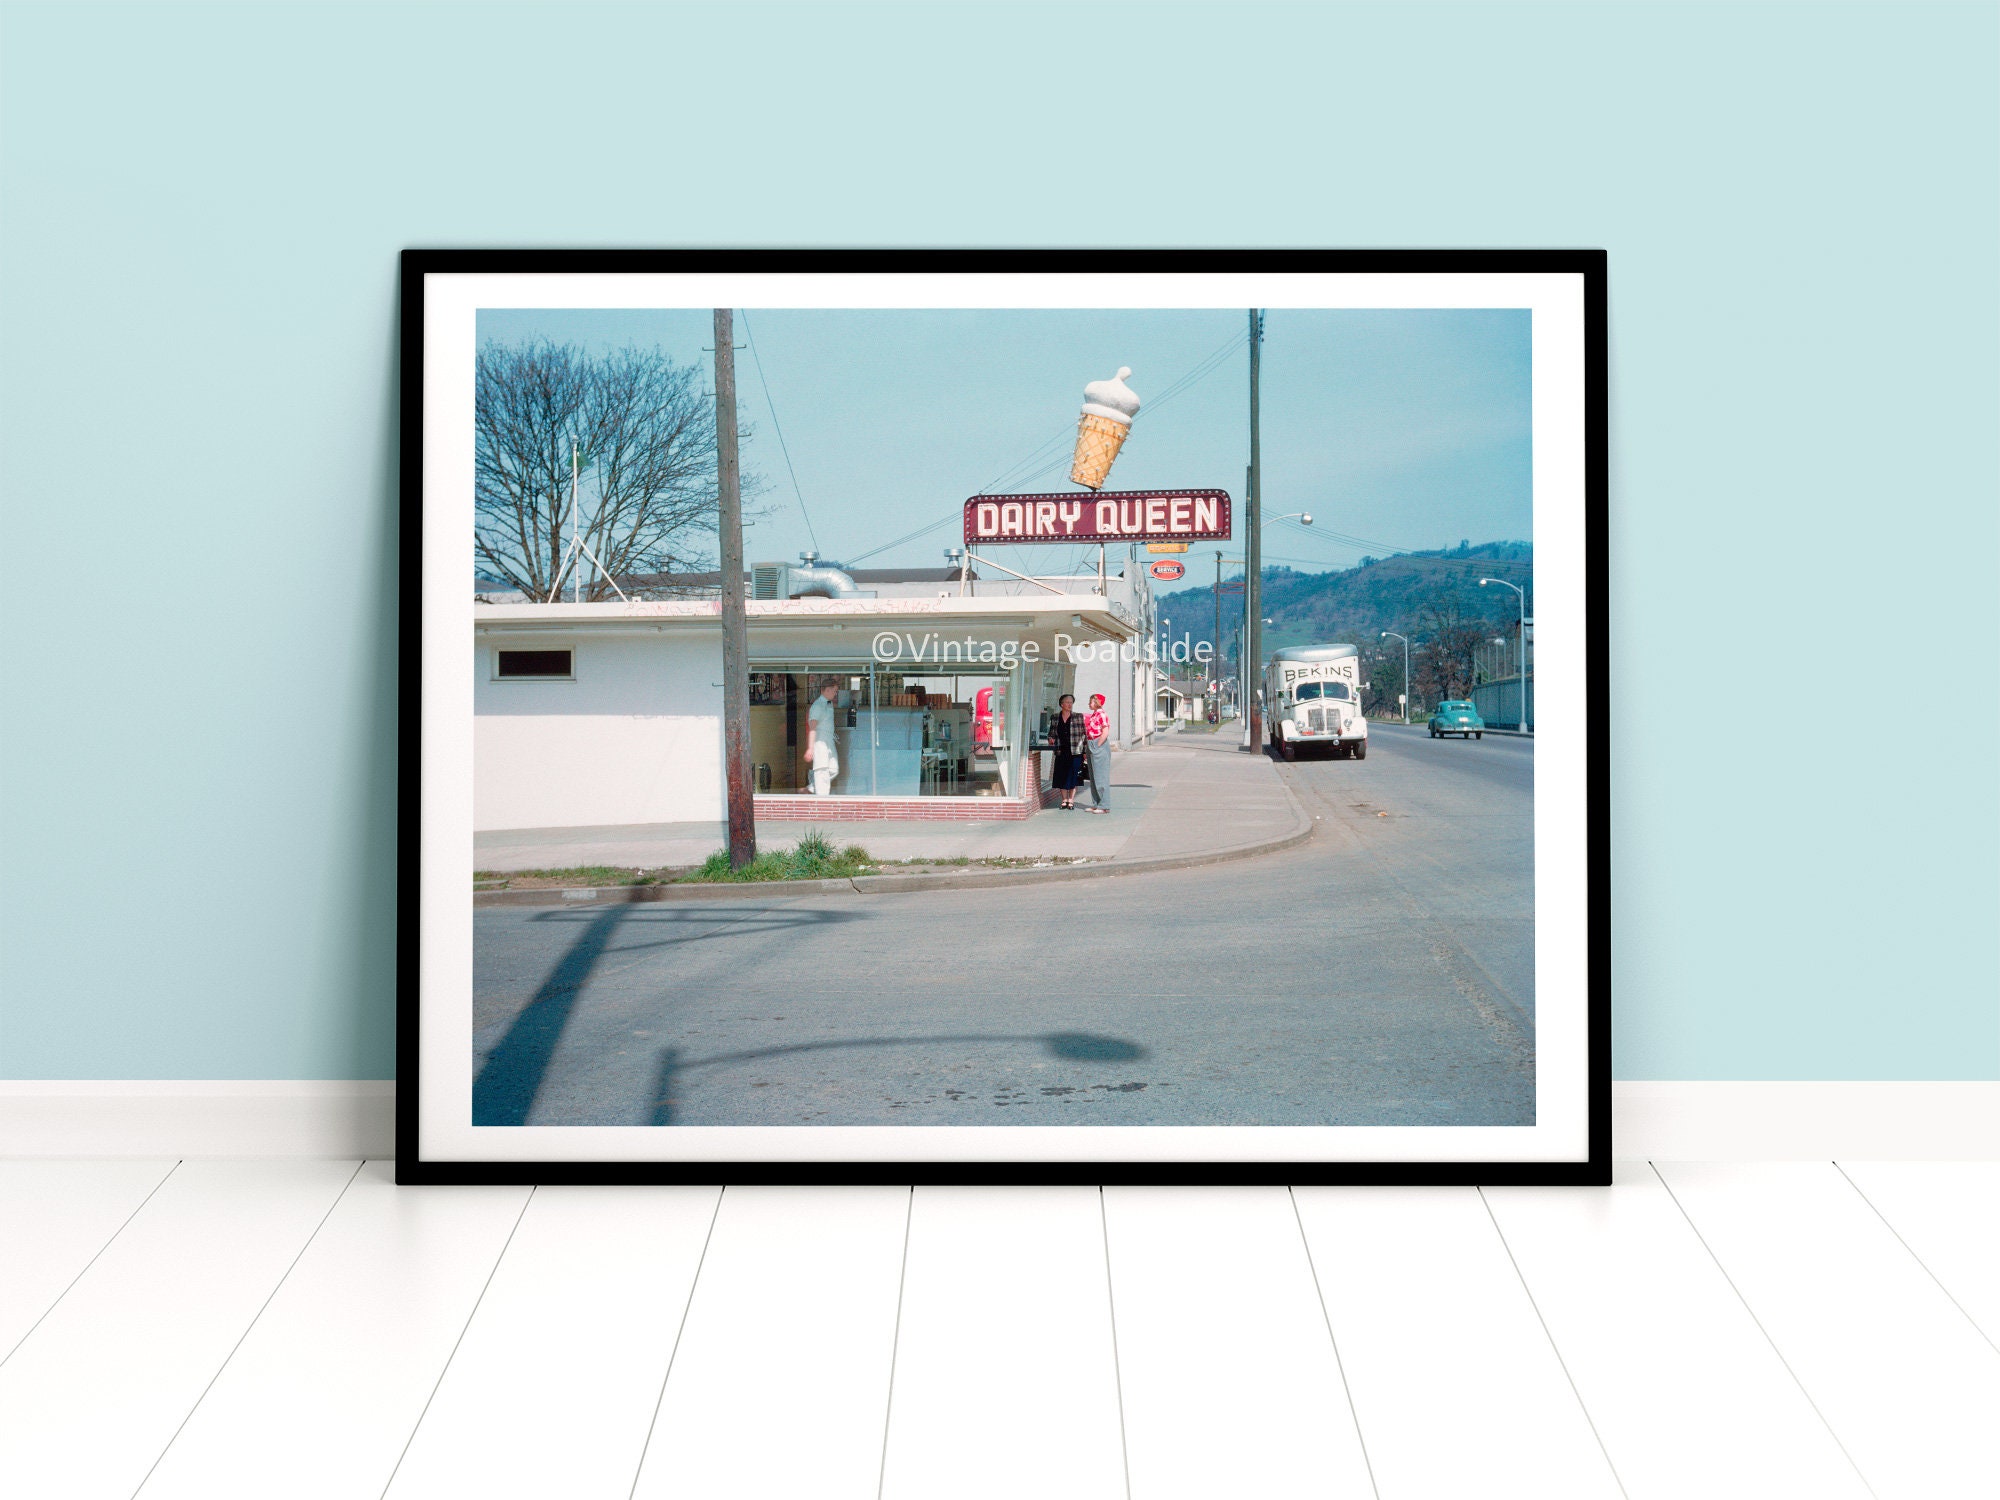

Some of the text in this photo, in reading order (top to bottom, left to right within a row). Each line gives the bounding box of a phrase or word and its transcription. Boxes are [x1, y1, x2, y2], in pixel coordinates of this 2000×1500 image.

[977, 498, 1218, 537] DAIRY QUEEN
[1285, 666, 1353, 682] BEKINS
